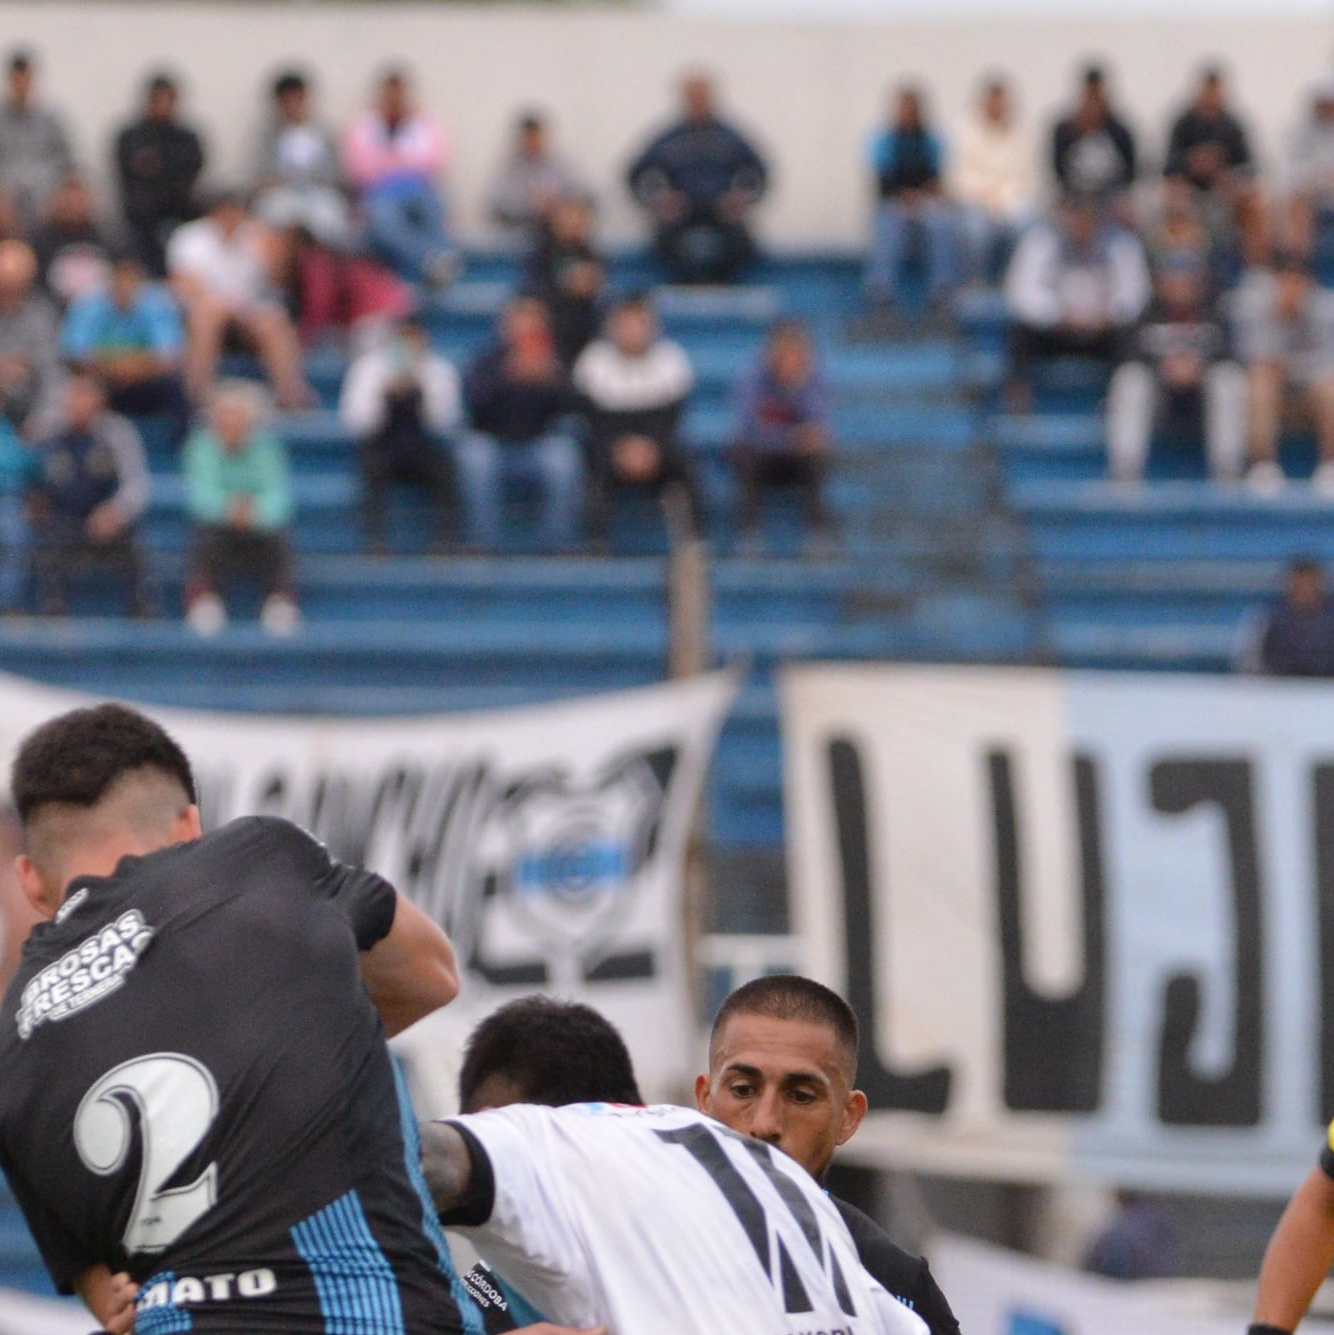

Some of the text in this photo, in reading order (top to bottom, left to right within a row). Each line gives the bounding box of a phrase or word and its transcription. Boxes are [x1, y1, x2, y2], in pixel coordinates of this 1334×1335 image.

[21, 914, 139, 1003] BROSAS
[73, 1052, 220, 1257] 2
[136, 1268, 276, 1312] MATO
